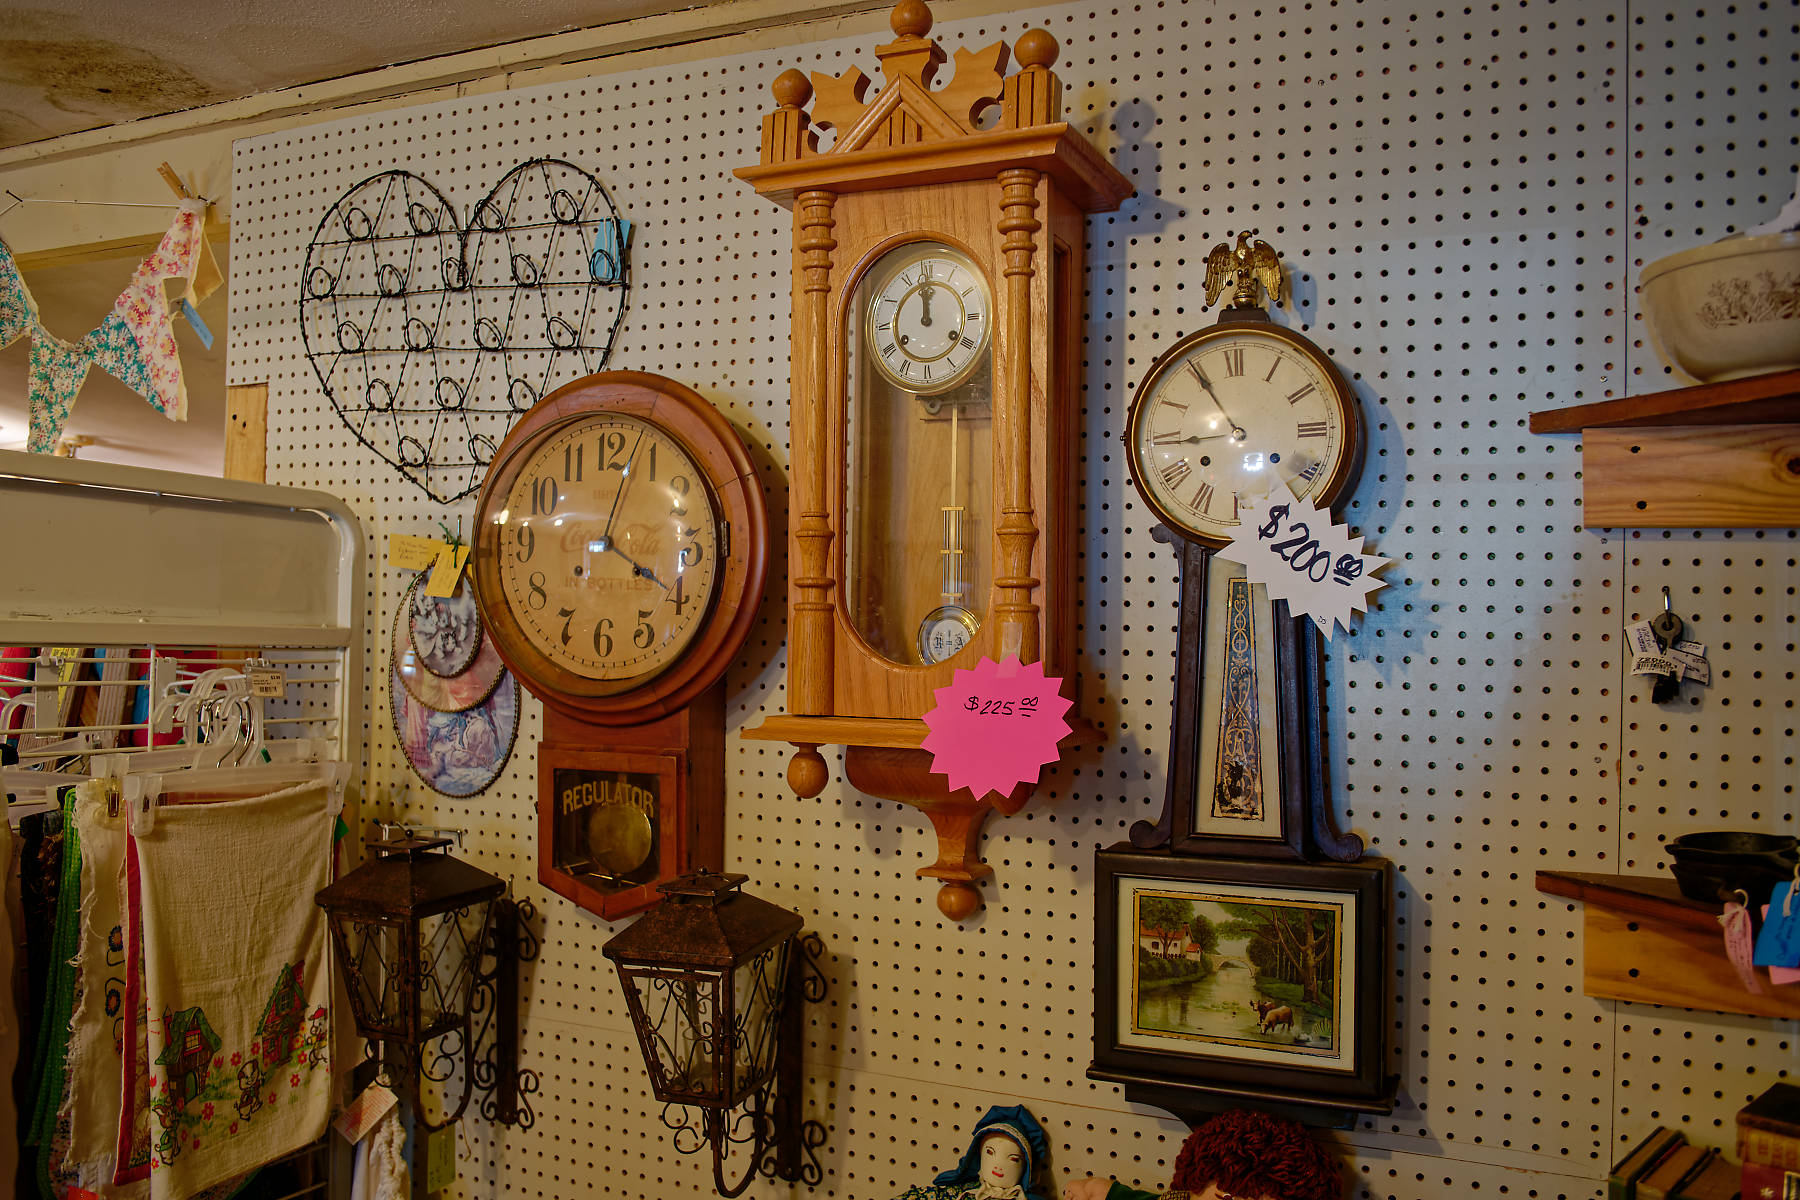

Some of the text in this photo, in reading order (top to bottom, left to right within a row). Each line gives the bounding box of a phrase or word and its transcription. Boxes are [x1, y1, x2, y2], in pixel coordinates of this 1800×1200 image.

[1297, 420, 1328, 440] III
[563, 442, 584, 483] 11
[597, 431, 627, 472] 12
[648, 441, 658, 483] 1
[531, 475, 559, 517] 10
[669, 474, 691, 517] 2
[515, 525, 536, 564] 9
[680, 526, 705, 568] 3
[527, 571, 548, 611] 8
[664, 575, 691, 616] 4
[557, 606, 577, 647] 7
[593, 618, 615, 658] 6
[633, 609, 656, 650] 5
[562, 780, 655, 819] REGULATOR
